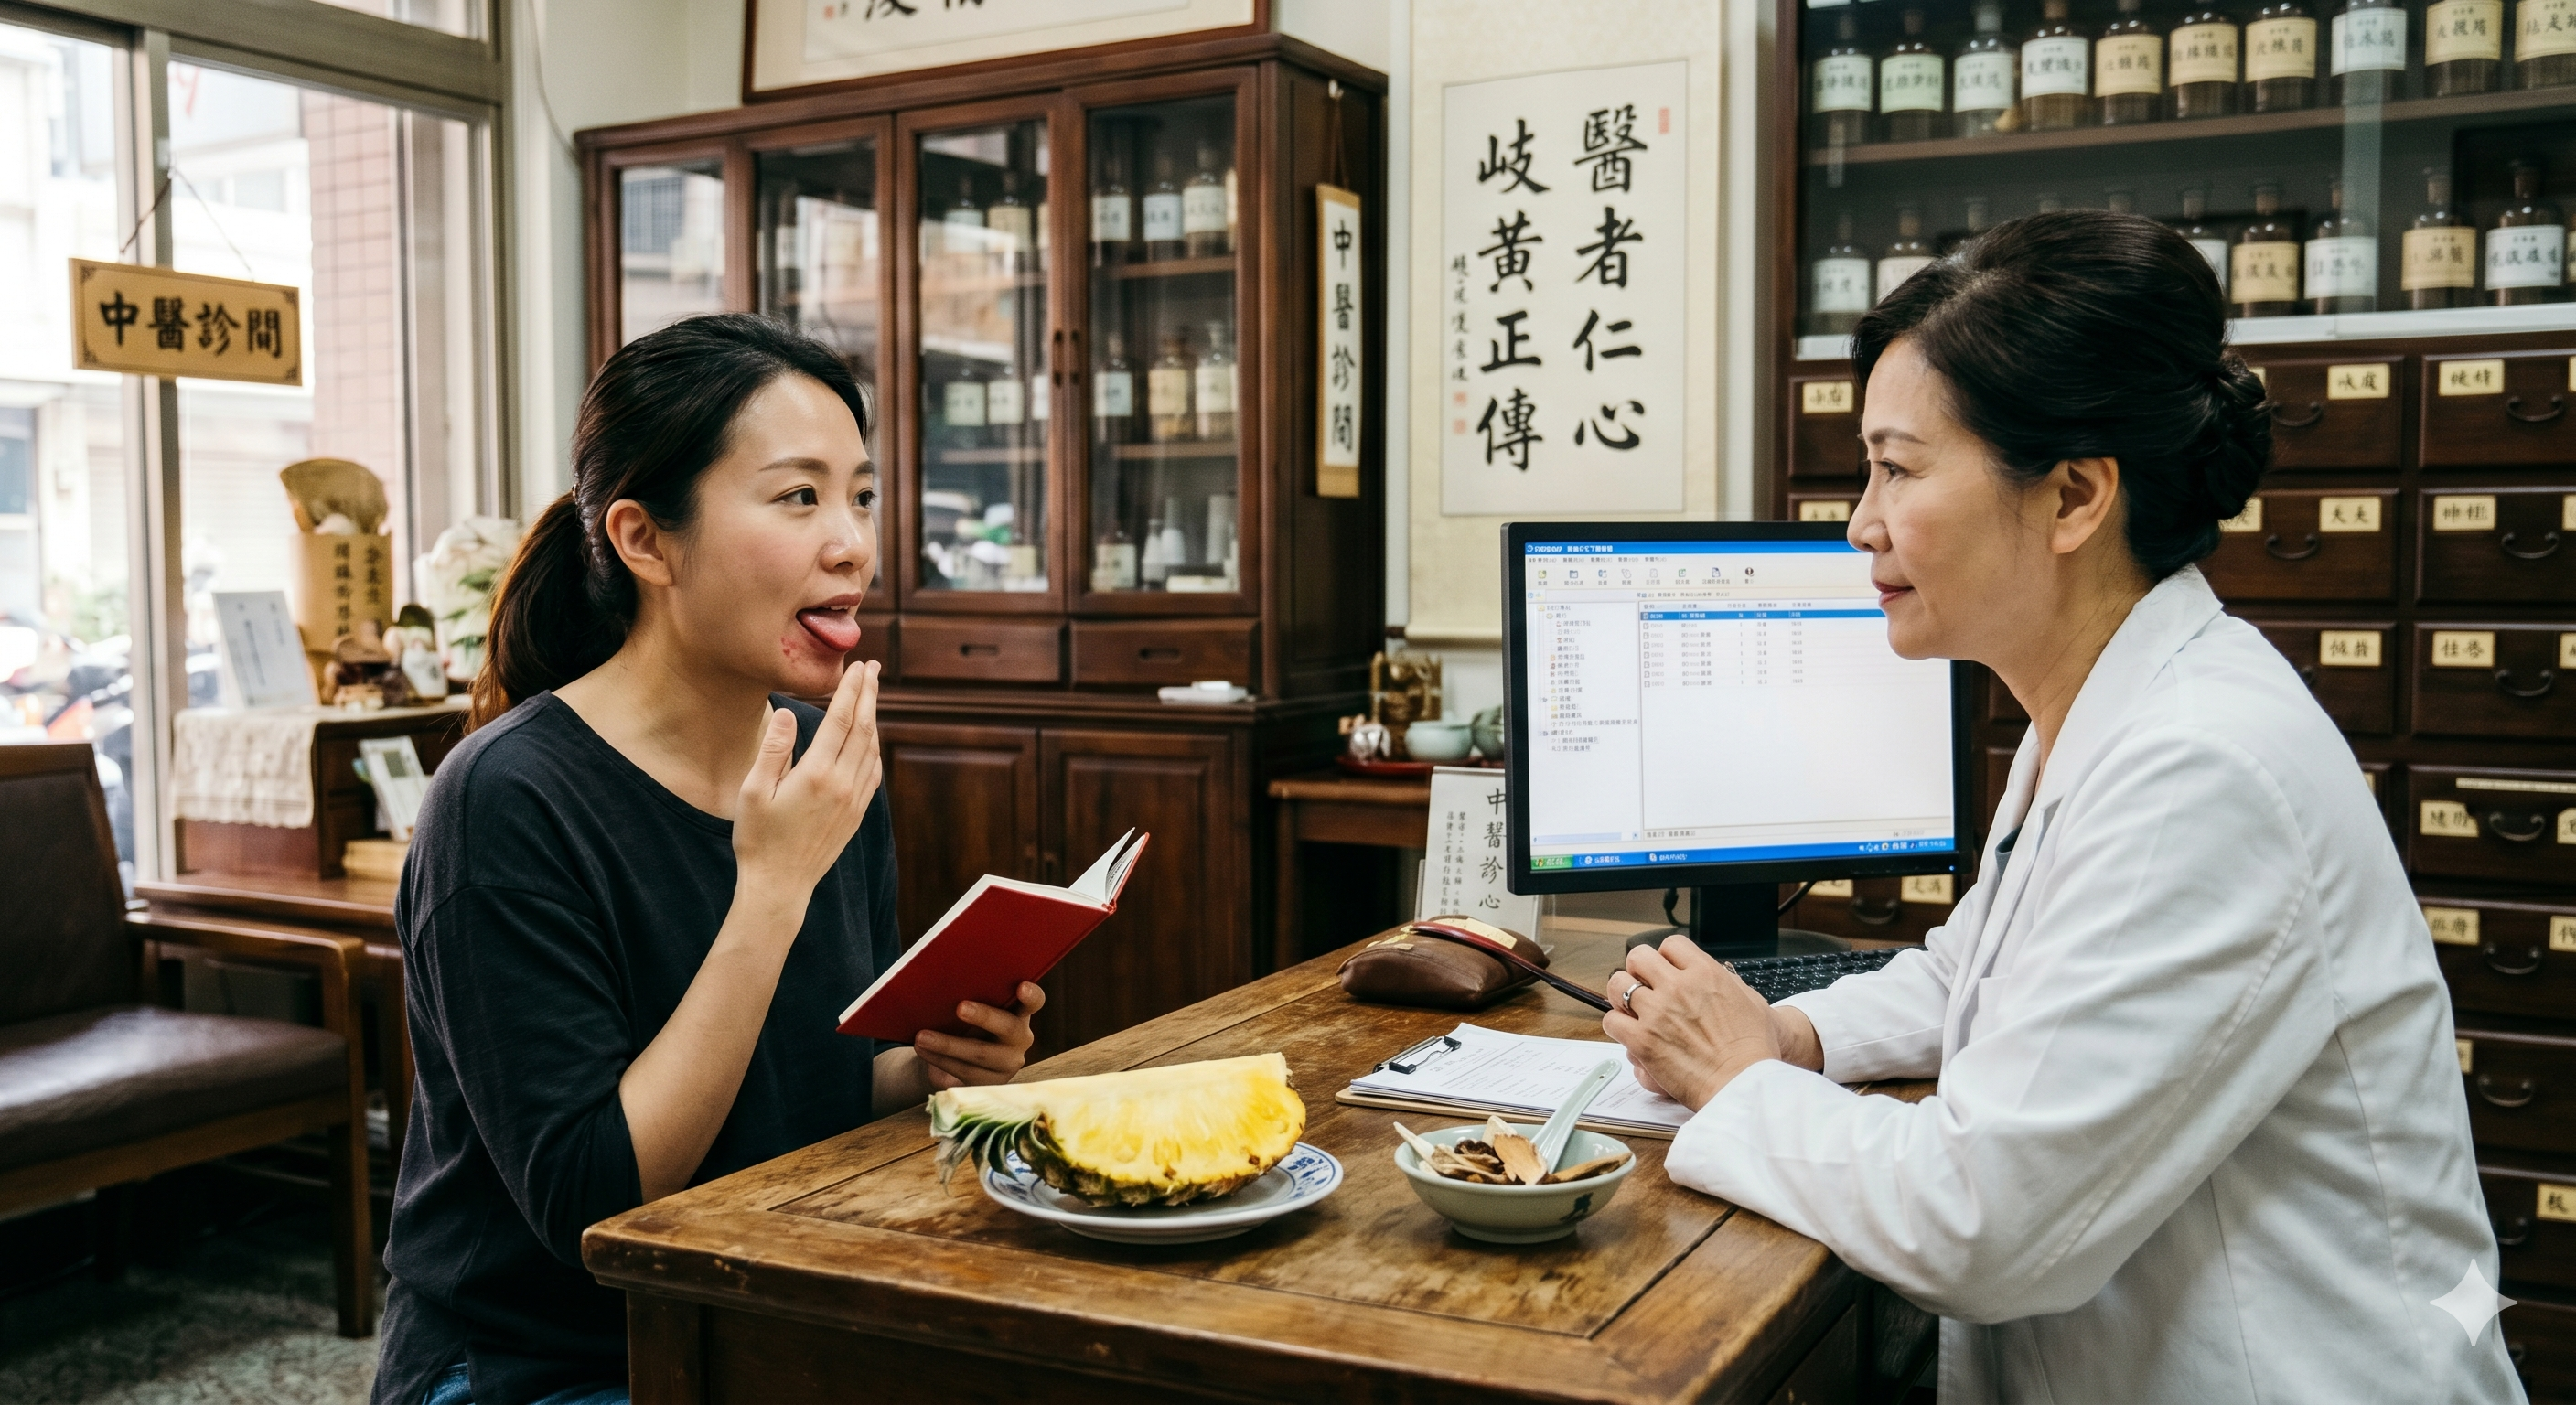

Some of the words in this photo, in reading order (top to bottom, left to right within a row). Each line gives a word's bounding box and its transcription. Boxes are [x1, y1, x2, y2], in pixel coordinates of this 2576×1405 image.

[1477, 119, 1551, 471] 岐黃正傳
[1573, 104, 1648, 451] 醫者仁心
